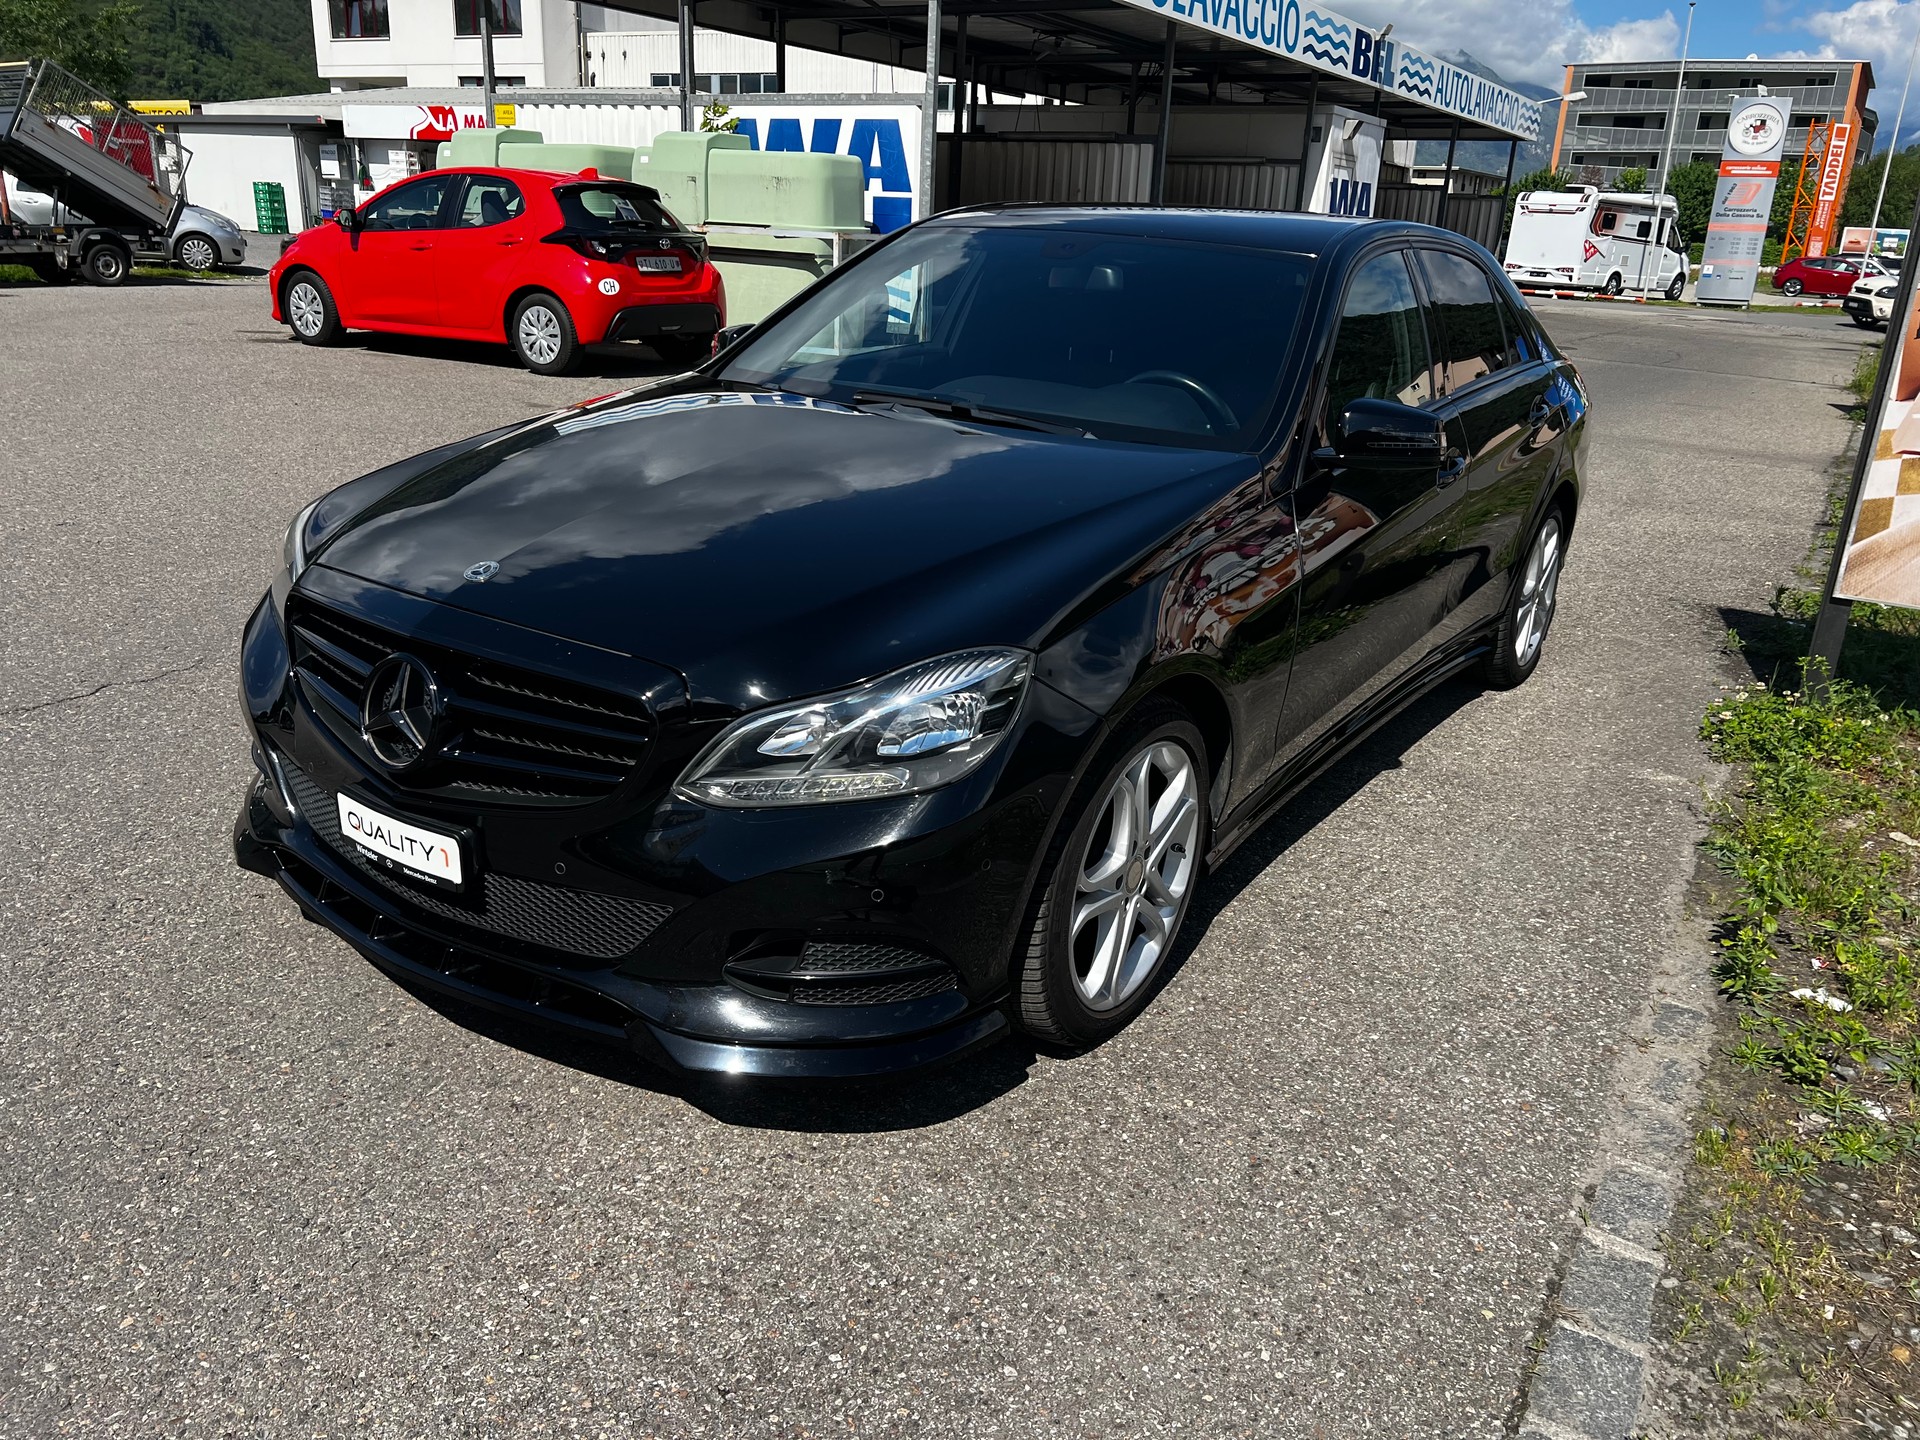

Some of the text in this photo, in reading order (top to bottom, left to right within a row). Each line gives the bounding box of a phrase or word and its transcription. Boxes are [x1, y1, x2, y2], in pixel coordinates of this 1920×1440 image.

[464, 114, 488, 129] MA
[1821, 144, 1844, 198] TADDEI
[603, 281, 616, 293] CH
[347, 811, 434, 861] QUALITY
[403, 867, 438, 885] Mercedes-Benz
